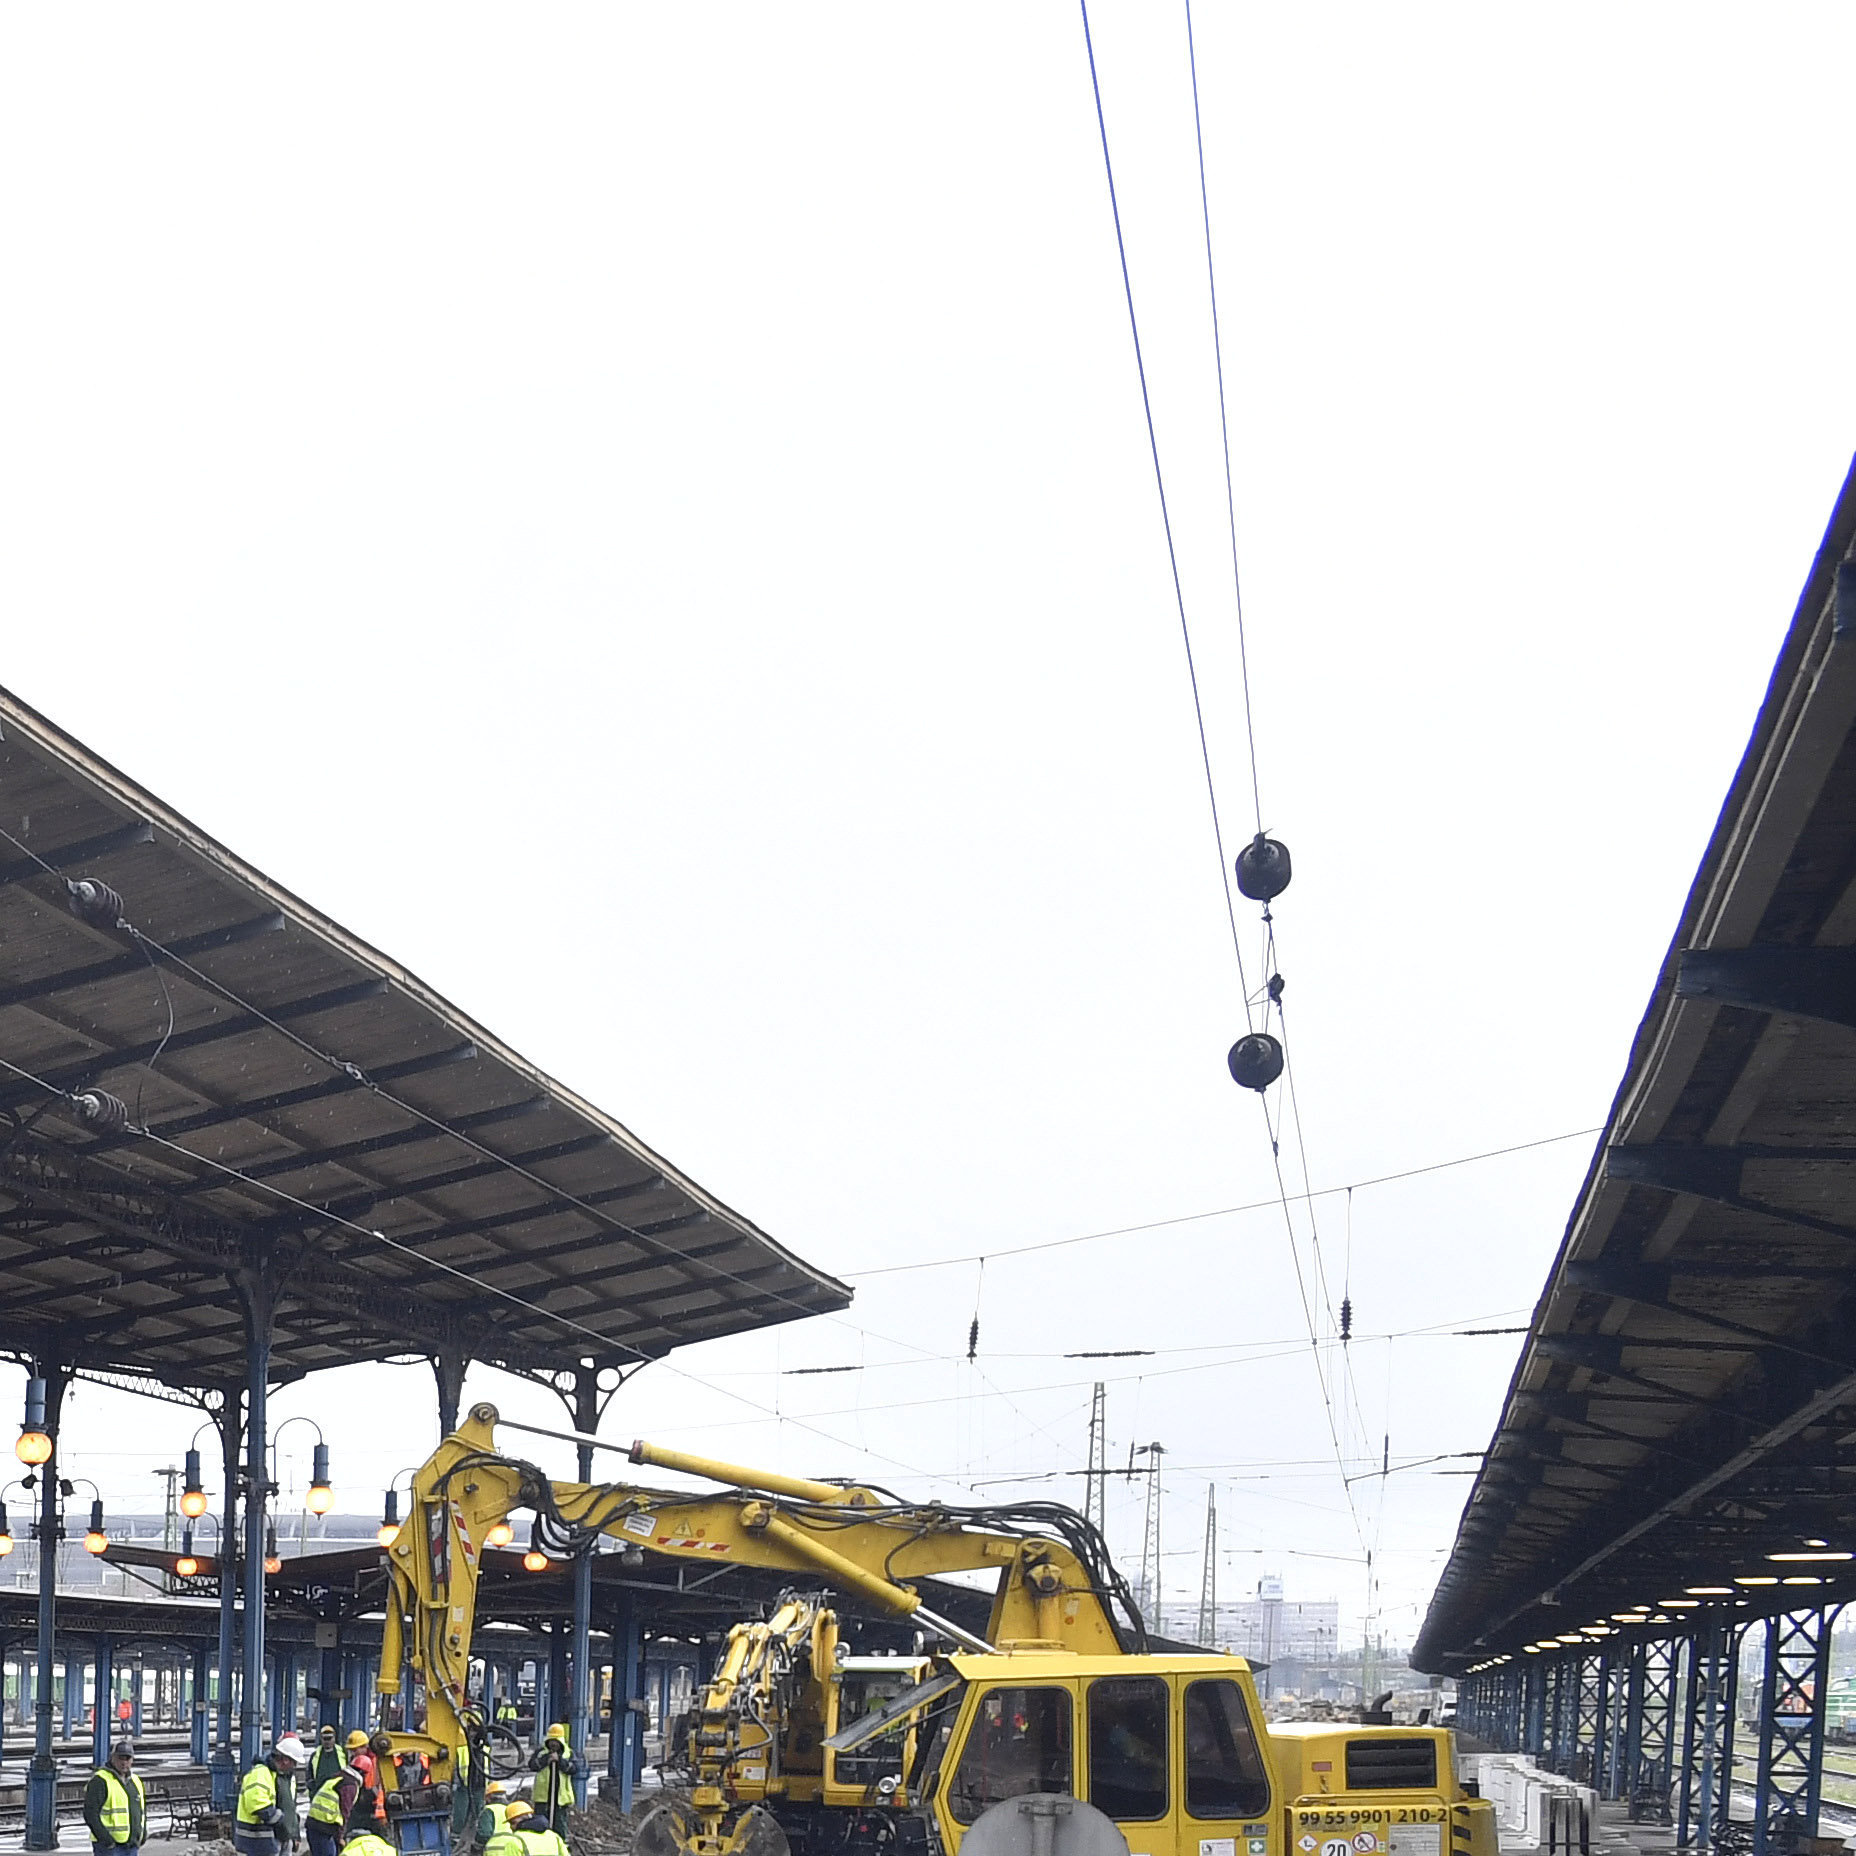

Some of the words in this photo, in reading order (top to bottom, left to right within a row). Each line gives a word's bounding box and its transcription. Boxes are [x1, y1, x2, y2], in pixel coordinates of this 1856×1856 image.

[1299, 1811, 1320, 1826] 99
[1324, 1810, 1345, 1825] 55
[1350, 1809, 1391, 1824] 9901
[1398, 1808, 1447, 1823] 210-2
